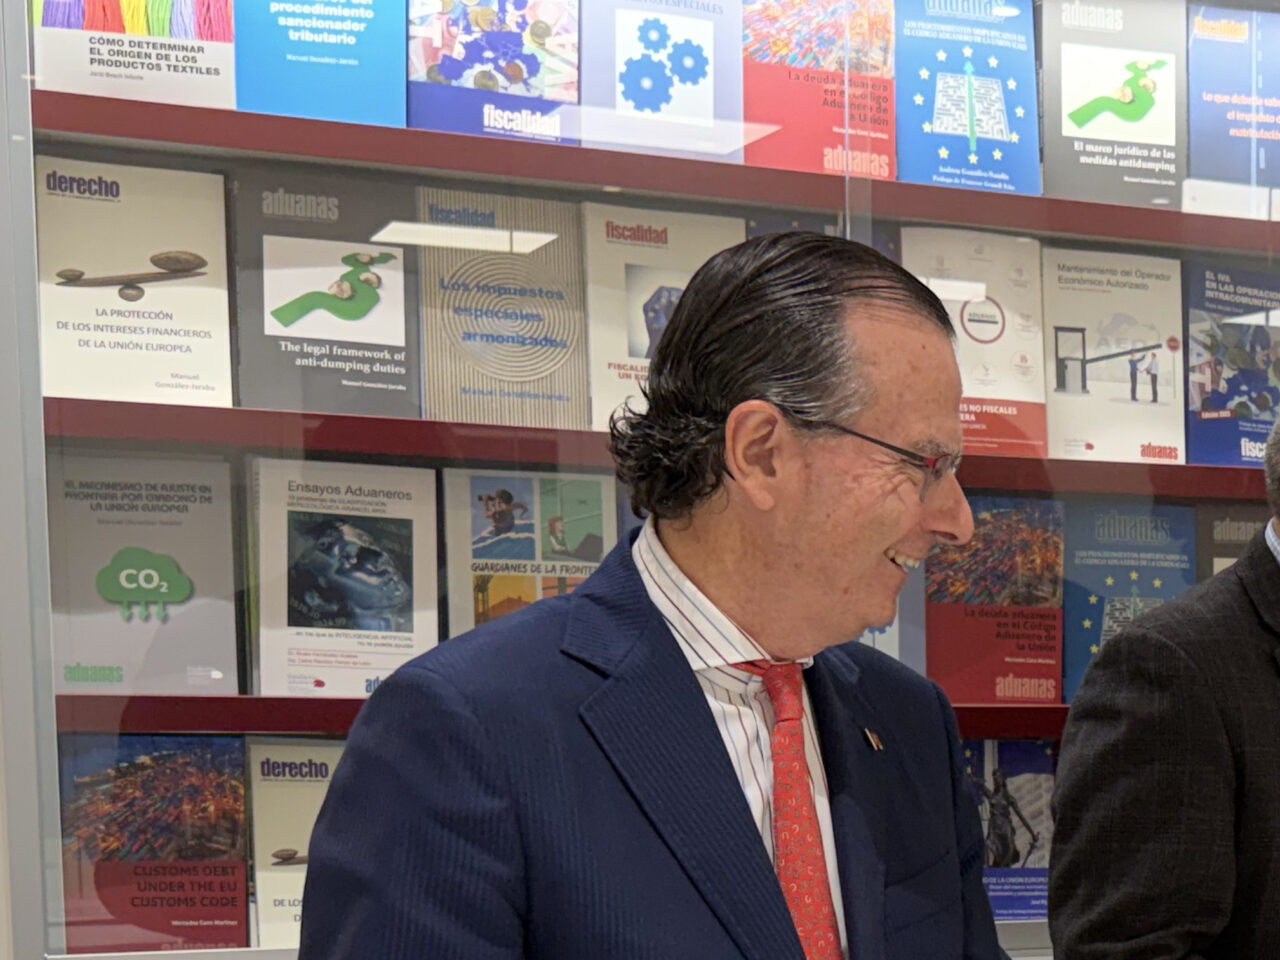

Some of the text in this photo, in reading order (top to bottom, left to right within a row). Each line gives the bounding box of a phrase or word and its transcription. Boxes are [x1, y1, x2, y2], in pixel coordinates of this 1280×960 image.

[270, 2, 374, 19] procedimiento
[1061, 0, 1124, 31] aduanas
[278, 17, 367, 32] sancionador
[89, 36, 205, 54] CÓMO DETERMINAR
[288, 29, 357, 45] tributario
[90, 47, 198, 64] EL ORIGEN DE LOS
[90, 57, 221, 76] PRODUCTOS TEXTILES
[804, 72, 836, 85] deuda
[824, 87, 836, 97] en
[483, 103, 561, 136] fiscalidad
[1074, 140, 1176, 159] El marco jurídico de las
[1080, 155, 1176, 174] medidas antidumping
[46, 170, 121, 199] derecho
[262, 187, 339, 221] aduanas
[428, 203, 495, 227] fiscalidad
[606, 220, 668, 245] fiscalidad
[1057, 263, 1172, 282] Mantenimiento del Operador
[1205, 269, 1231, 283] EL IVA
[440, 277, 565, 301] Los impuestos
[1057, 274, 1105, 287] Económico
[1105, 279, 1150, 291] Autorizado
[1205, 280, 1218, 289] EN
[1218, 283, 1235, 293] LAS
[95, 308, 173, 321] LA PROTECCIÓN
[454, 304, 544, 323] especiales
[56, 320, 212, 340] DE LOS INTERESES FINANCIEROS
[78, 339, 193, 354] DE LA UNIÓN EUROPEA
[462, 330, 569, 349] armonizados
[278, 340, 406, 361] The legal framework of
[295, 357, 406, 375] anti-dumping duties
[618, 372, 632, 380] UN
[969, 404, 1018, 416] NO FISCALES
[1140, 441, 1178, 460] aduanas
[78, 480, 143, 492] MECANISMO
[145, 482, 159, 492] DE
[288, 480, 341, 496] Ensayos
[344, 485, 413, 500] Aduaneros
[121, 492, 144, 502] POR
[199, 495, 214, 505] DE
[1095, 509, 1170, 543] aduanas
[471, 562, 557, 574] GUARDIANES DE LA
[964, 607, 1056, 621] La deuda aduanera
[996, 620, 1056, 634] en el Código
[995, 631, 1056, 642] Aduanero de
[1016, 641, 1056, 652] la Unión
[64, 661, 124, 683] aduanas
[995, 672, 1056, 699] aduanas
[261, 757, 329, 778] derecho
[133, 865, 238, 877] CUSTOMS DEBT
[137, 880, 238, 893] UNDER THE EU
[131, 896, 238, 908] CUSTOMS CODE
[273, 899, 287, 907] DE
